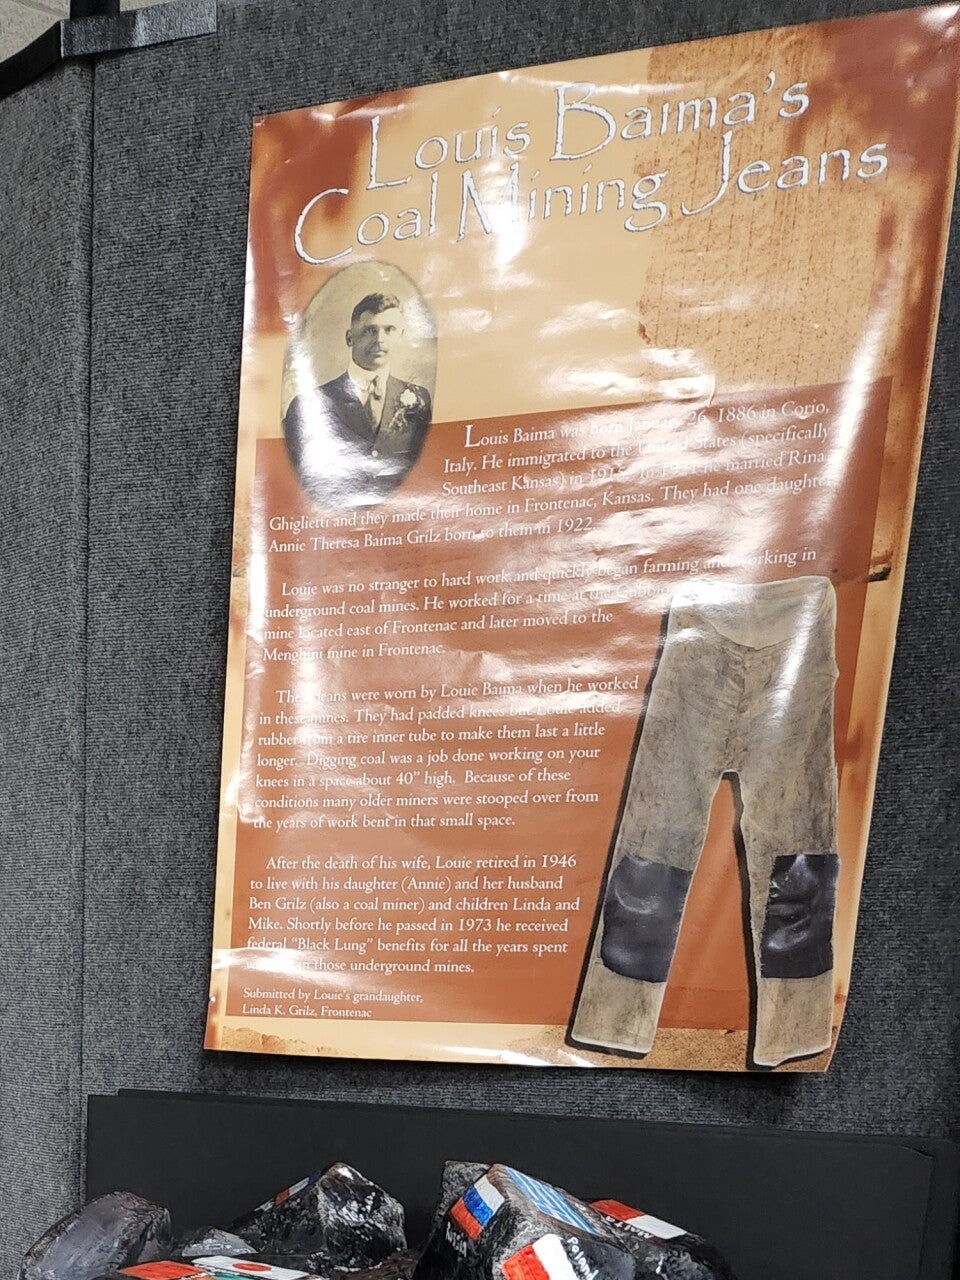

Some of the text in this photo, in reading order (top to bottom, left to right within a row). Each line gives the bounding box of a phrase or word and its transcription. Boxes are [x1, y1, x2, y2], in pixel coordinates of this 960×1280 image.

[366, 71, 809, 190] Louis Baima's
[294, 130, 889, 265] Coal Mining Jeans
[268, 538, 306, 554] Annie
[309, 534, 359, 551] Theresa
[363, 531, 402, 547] Baima
[406, 528, 441, 544] Grilz
[498, 521, 533, 537] them
[556, 516, 596, 533] 1922.
[263, 626, 294, 640] mine
[346, 624, 370, 636] east
[373, 620, 391, 634] of
[391, 617, 457, 634] Frontenac
[460, 616, 485, 630] and
[488, 614, 519, 629] later
[522, 612, 568, 627] moved
[572, 613, 587, 625] to
[591, 609, 613, 624] the
[254, 789, 598, 811] conditions many older miners were stooped over from
[265, 853, 576, 871] After the death of his wife, Louie retired in 1946
[249, 876, 563, 894] to live with his daughter (Annie) and her husband
[248, 896, 580, 914] Ben Grilz (also a coal miner) and children Linda and
[248, 916, 568, 935] Mike. Shortly before he passed in 1973 he received
[242, 987, 423, 1005] Submitted by Louie's grandaughter,
[241, 1003, 372, 1018] Linda K. Grilz, Frontenac
